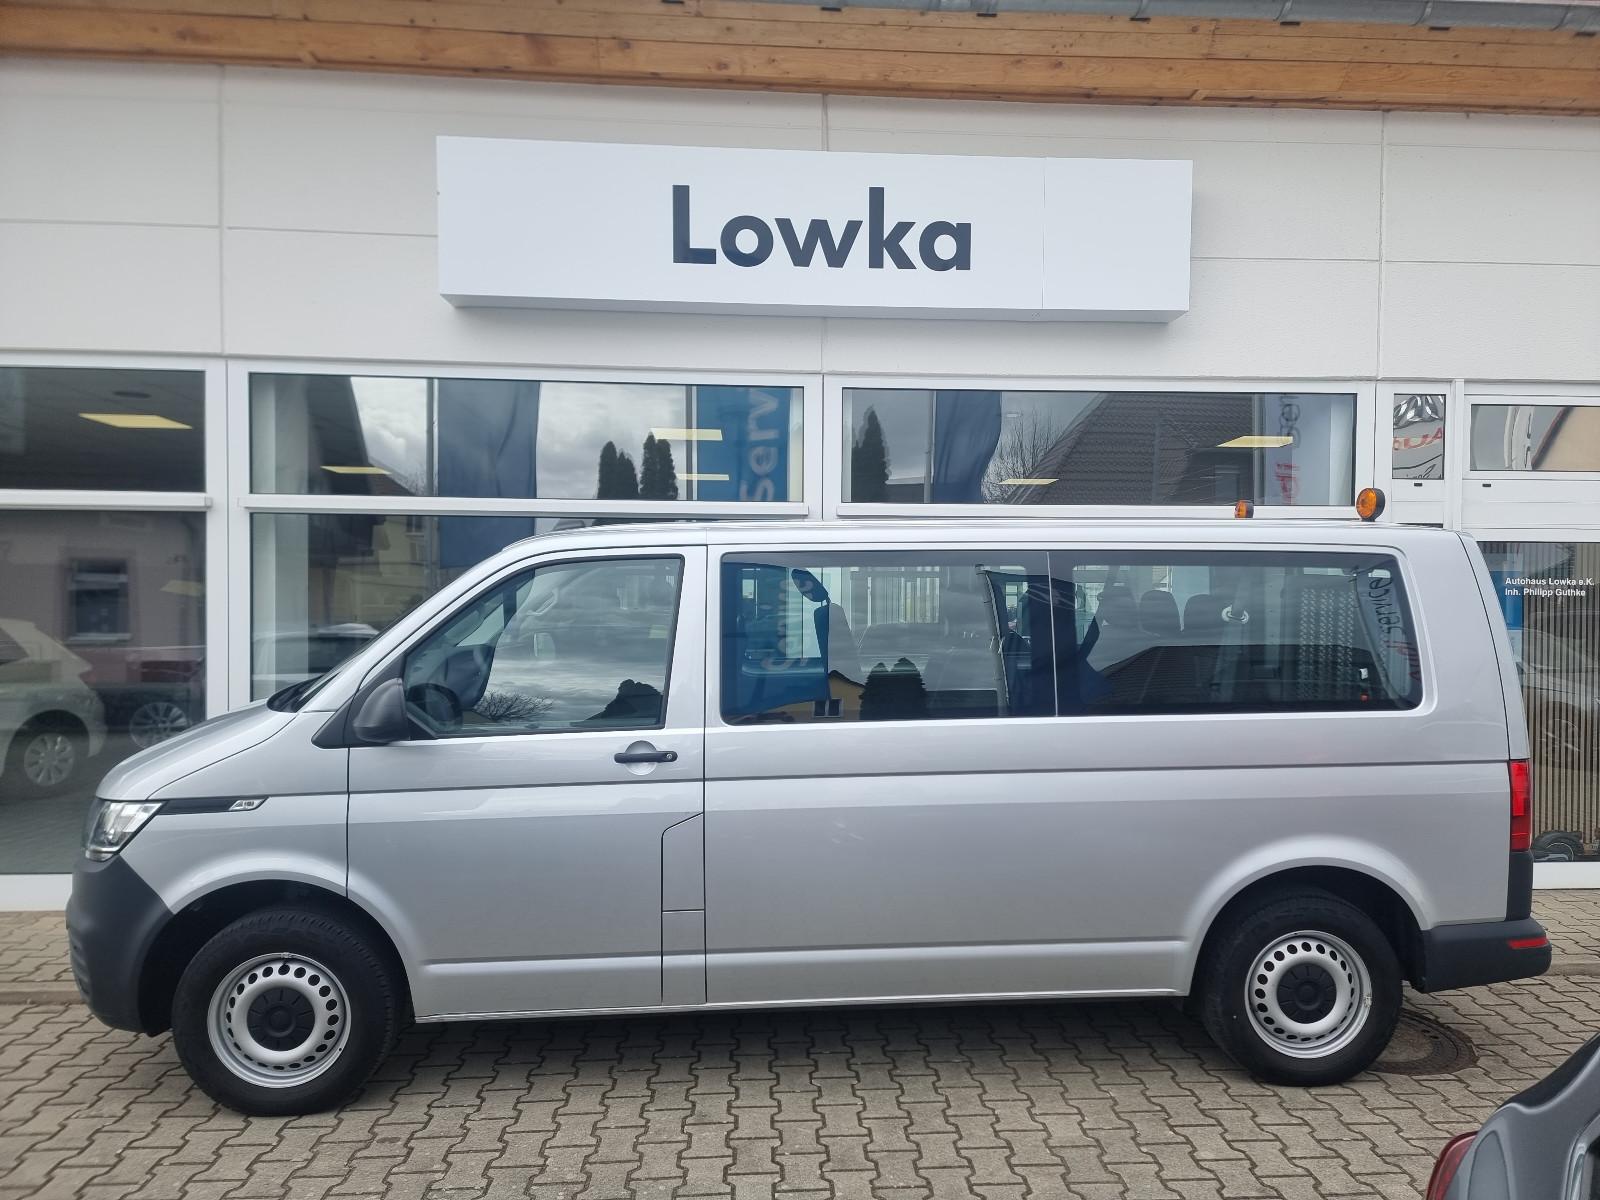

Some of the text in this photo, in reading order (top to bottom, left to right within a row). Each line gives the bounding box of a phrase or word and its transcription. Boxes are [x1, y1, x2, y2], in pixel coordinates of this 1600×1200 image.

[672, 185, 972, 271] Lowka
[739, 388, 781, 501] Serv
[1504, 588, 1586, 598] Inh. Philipp Guthke
[1505, 577, 1595, 586] Autohaus Lowka e.K.
